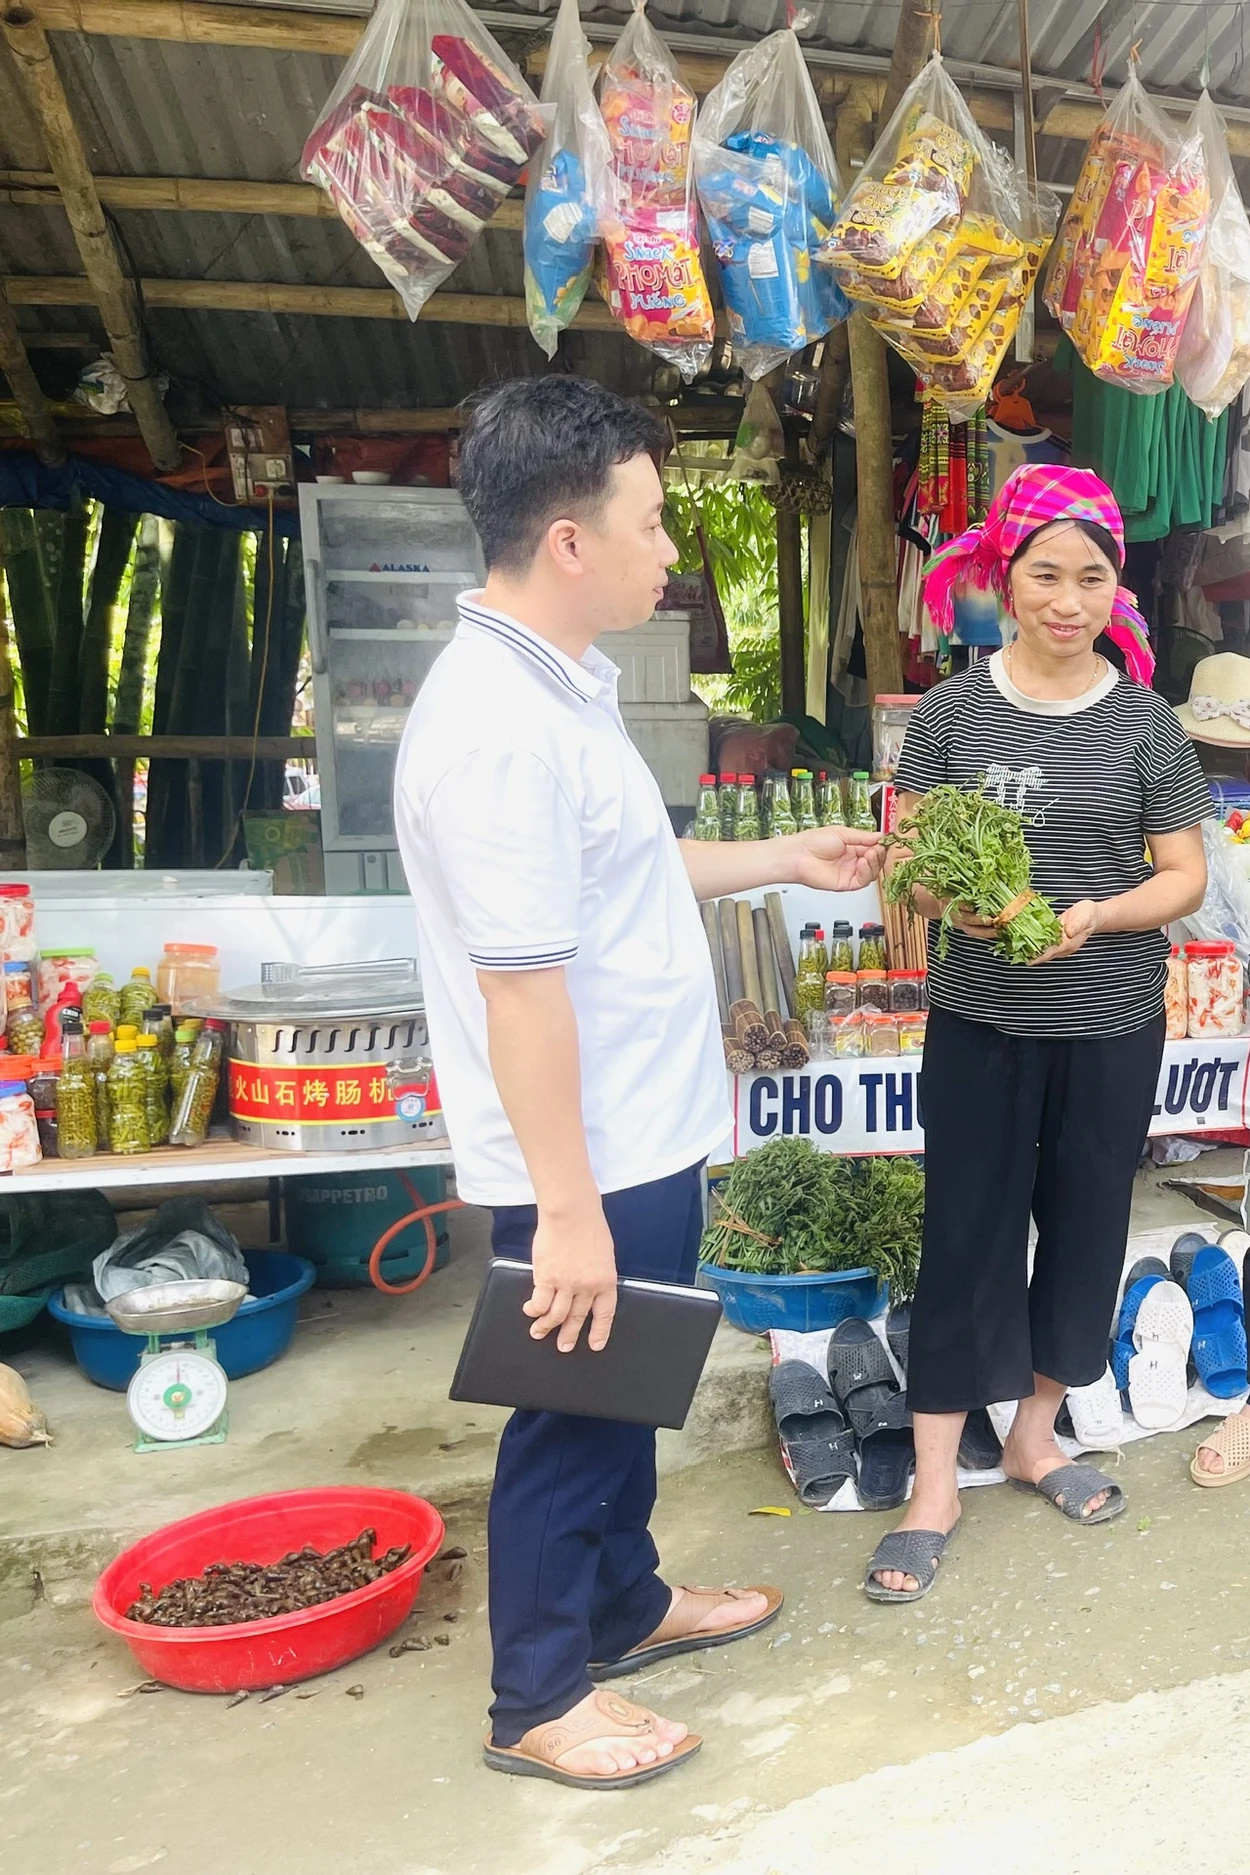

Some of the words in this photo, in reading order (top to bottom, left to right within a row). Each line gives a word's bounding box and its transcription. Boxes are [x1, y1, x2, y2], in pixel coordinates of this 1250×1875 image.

[382, 563, 431, 573] ALASKA
[235, 1074, 395, 1107] 火山石烤肠机
[749, 1073, 843, 1137] CHO
[1152, 1056, 1240, 1125] ƯỢT
